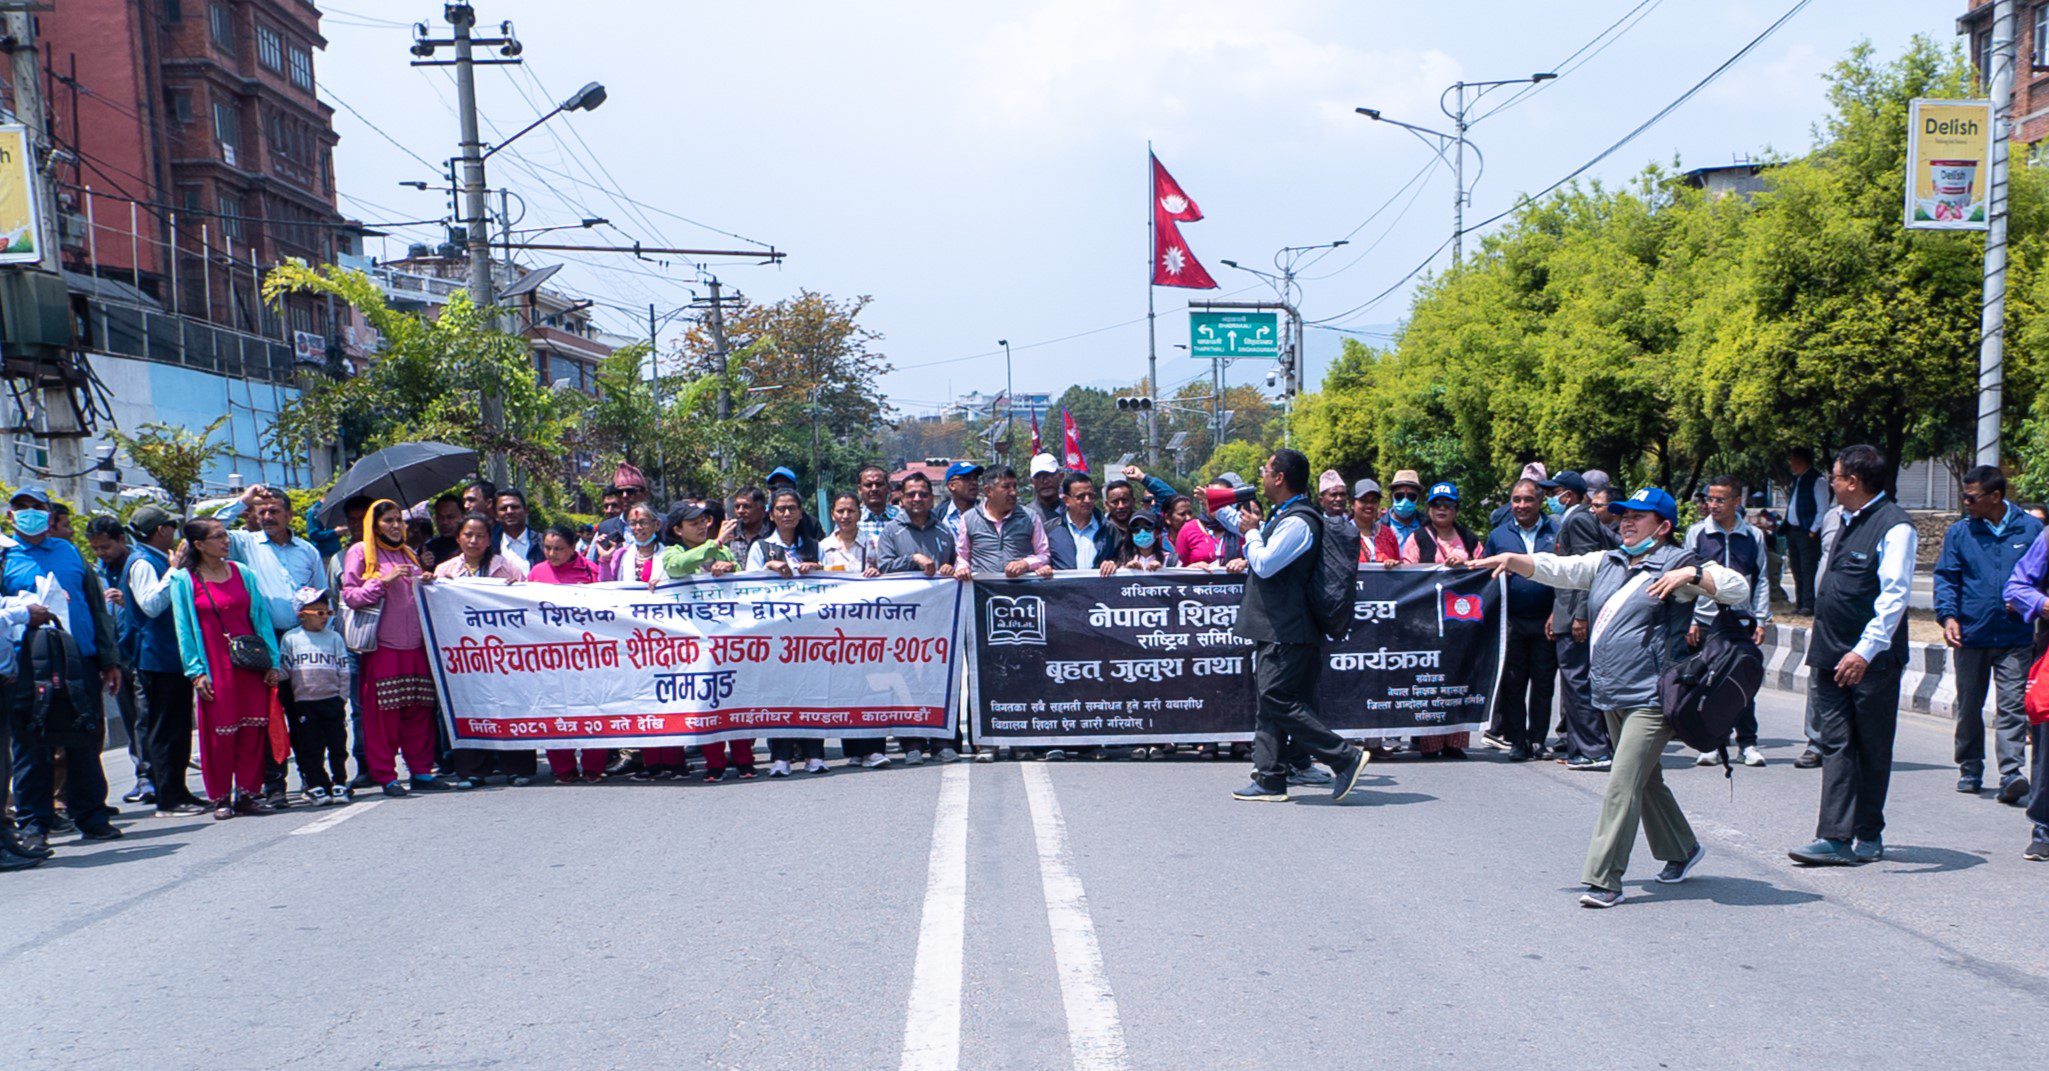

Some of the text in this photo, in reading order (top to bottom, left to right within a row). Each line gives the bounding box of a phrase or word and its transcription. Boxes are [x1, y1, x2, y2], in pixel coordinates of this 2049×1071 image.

[1925, 117, 1978, 135] Delish
[1121, 583, 1172, 597] अधिकार
[1177, 585, 1187, 596] र
[465, 596, 921, 629] नेपाल शिक्षक महासङ्घ द्वारा आयोजित
[994, 603, 1036, 618] cnt
[1088, 600, 1241, 628] नेपाल शिक्ष
[442, 631, 619, 675] अनिश्चितकालीन
[625, 627, 700, 669] शैक्षिक
[708, 635, 773, 666] सडक
[1136, 629, 1190, 651] राष्ट्रिय
[1110, 657, 1185, 683] जुलुश
[1192, 656, 1244, 676] तथा
[1330, 647, 1441, 671] कार्यक्रम
[653, 669, 737, 708] लमजुङ
[509, 722, 548, 736] २०८१
[554, 717, 578, 732] चैत्र
[584, 720, 603, 734] २०
[610, 716, 631, 731] गते
[637, 715, 665, 731] देखि
[1080, 716, 1103, 729] जारी
